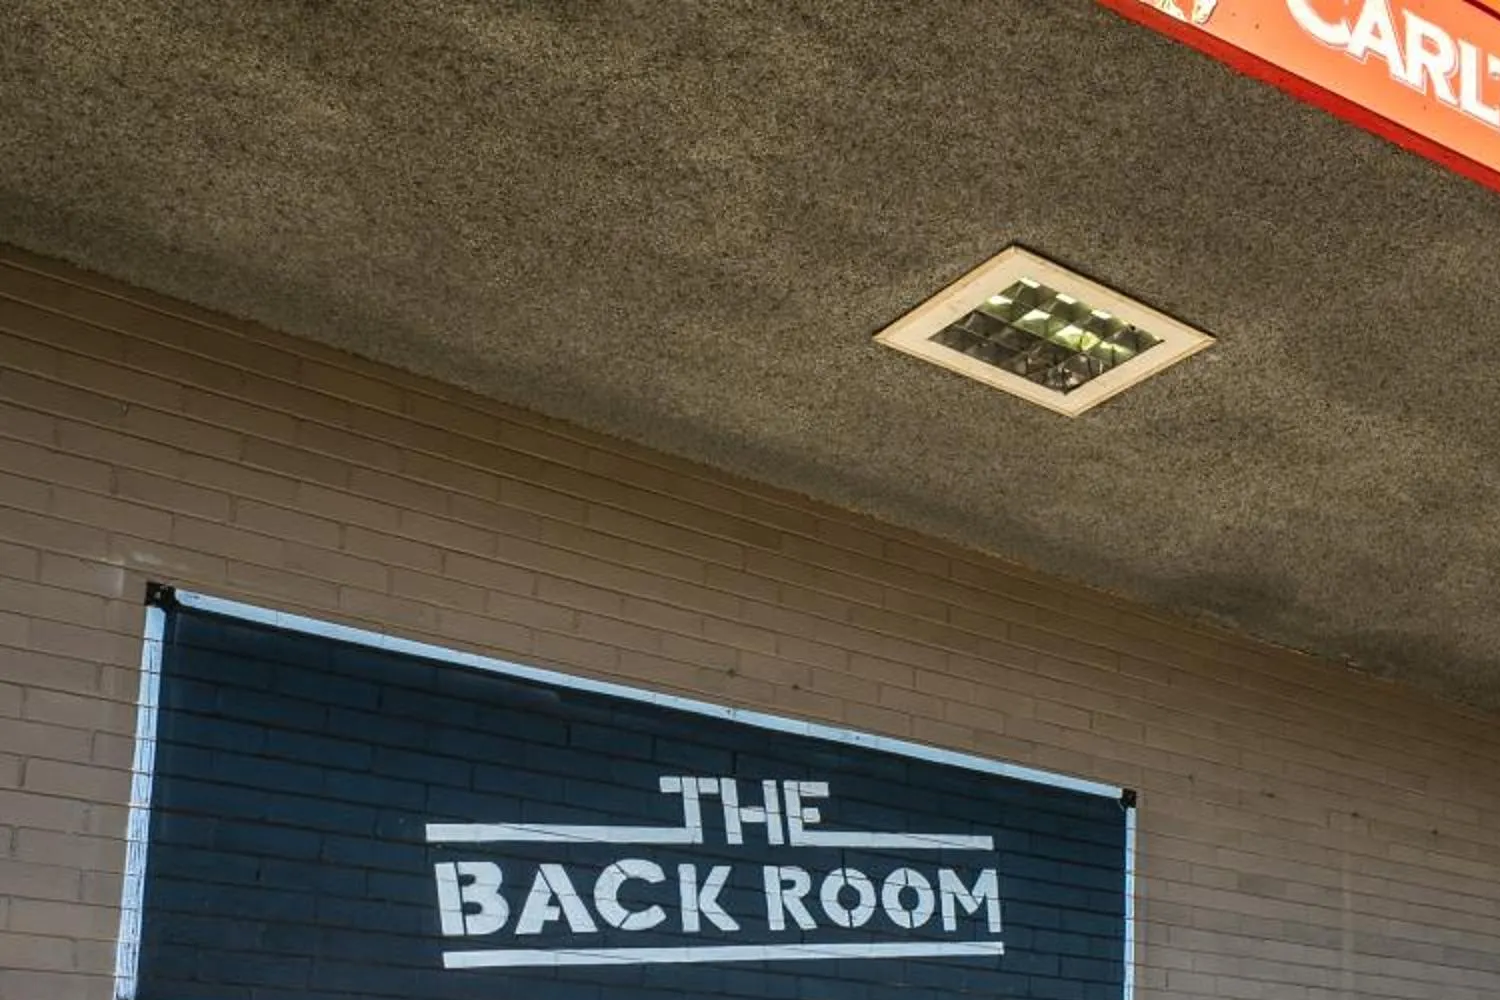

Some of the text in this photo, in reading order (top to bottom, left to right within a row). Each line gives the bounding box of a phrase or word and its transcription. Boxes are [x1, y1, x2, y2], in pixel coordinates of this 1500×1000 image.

[659, 775, 830, 846] THE
[434, 858, 1001, 936] BACK ROOM
